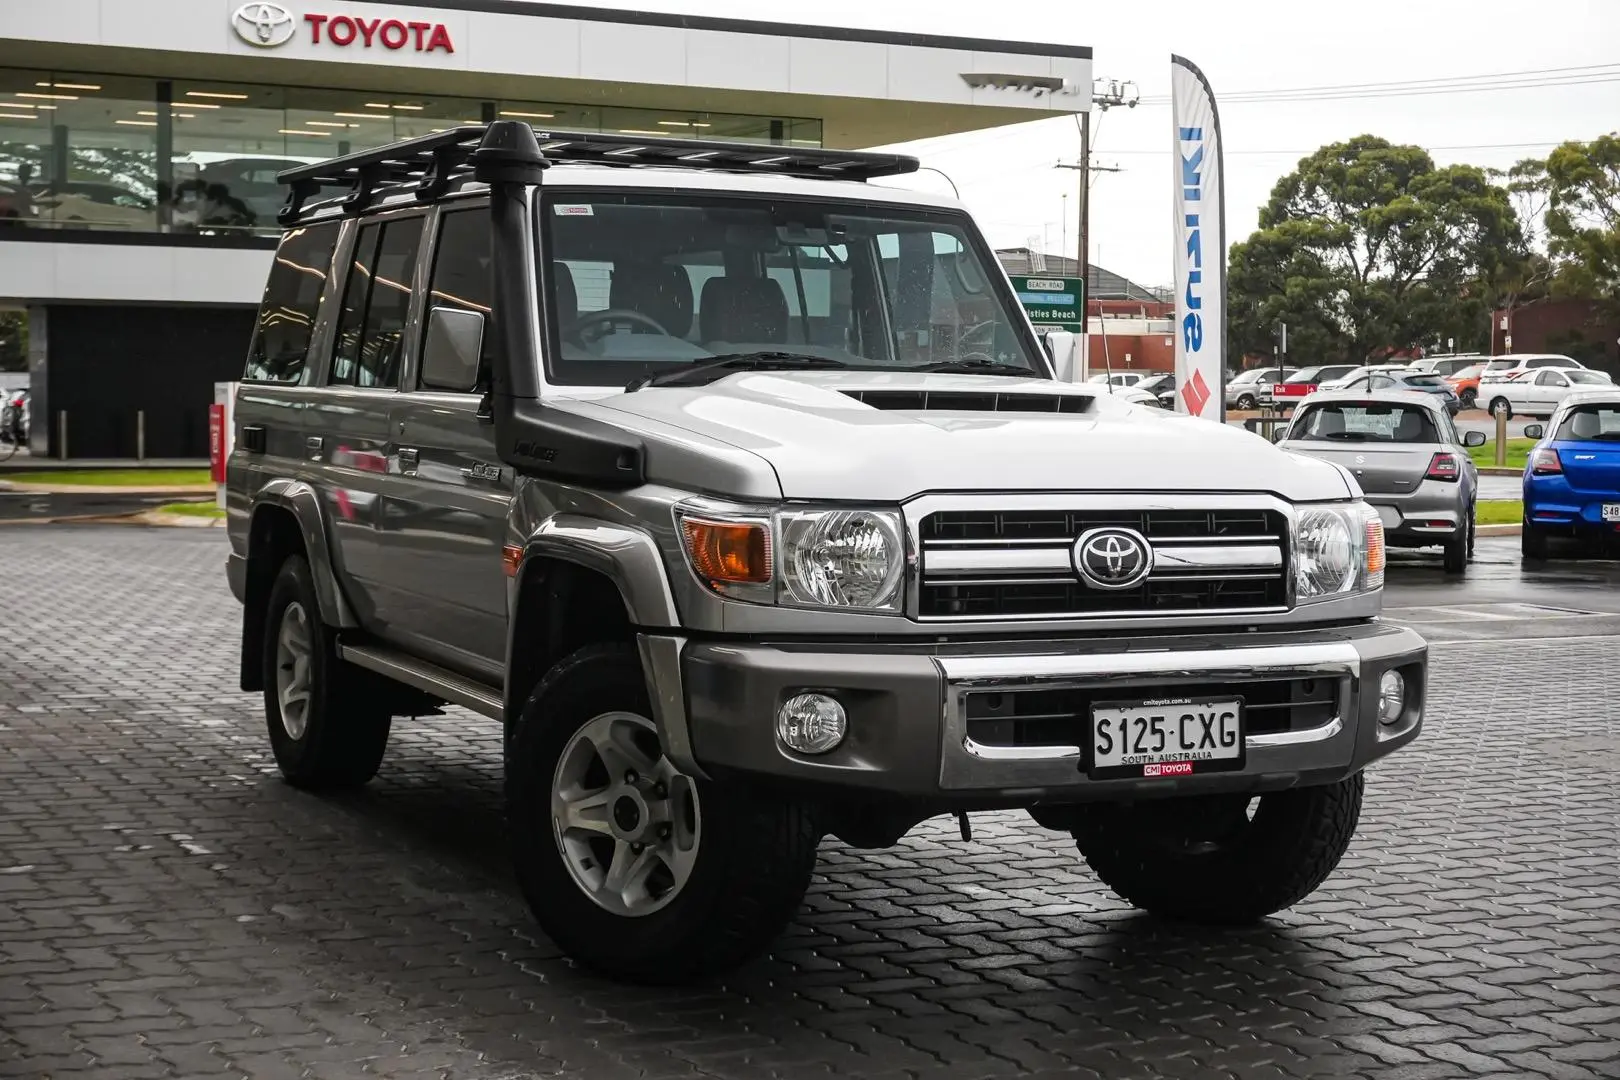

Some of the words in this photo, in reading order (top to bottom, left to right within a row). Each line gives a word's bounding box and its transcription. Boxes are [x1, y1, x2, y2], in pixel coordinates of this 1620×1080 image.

[304, 14, 454, 53] TOYOTA
[1027, 310, 1050, 318] isties
[1051, 310, 1076, 319] Beach
[1143, 698, 1192, 707] cmitoyota.com.au
[1121, 755, 1155, 765] SOUTH
[1158, 751, 1213, 762] AUSTRALIA
[1144, 764, 1161, 775] CMI
[1161, 763, 1192, 773] TOYOTA
